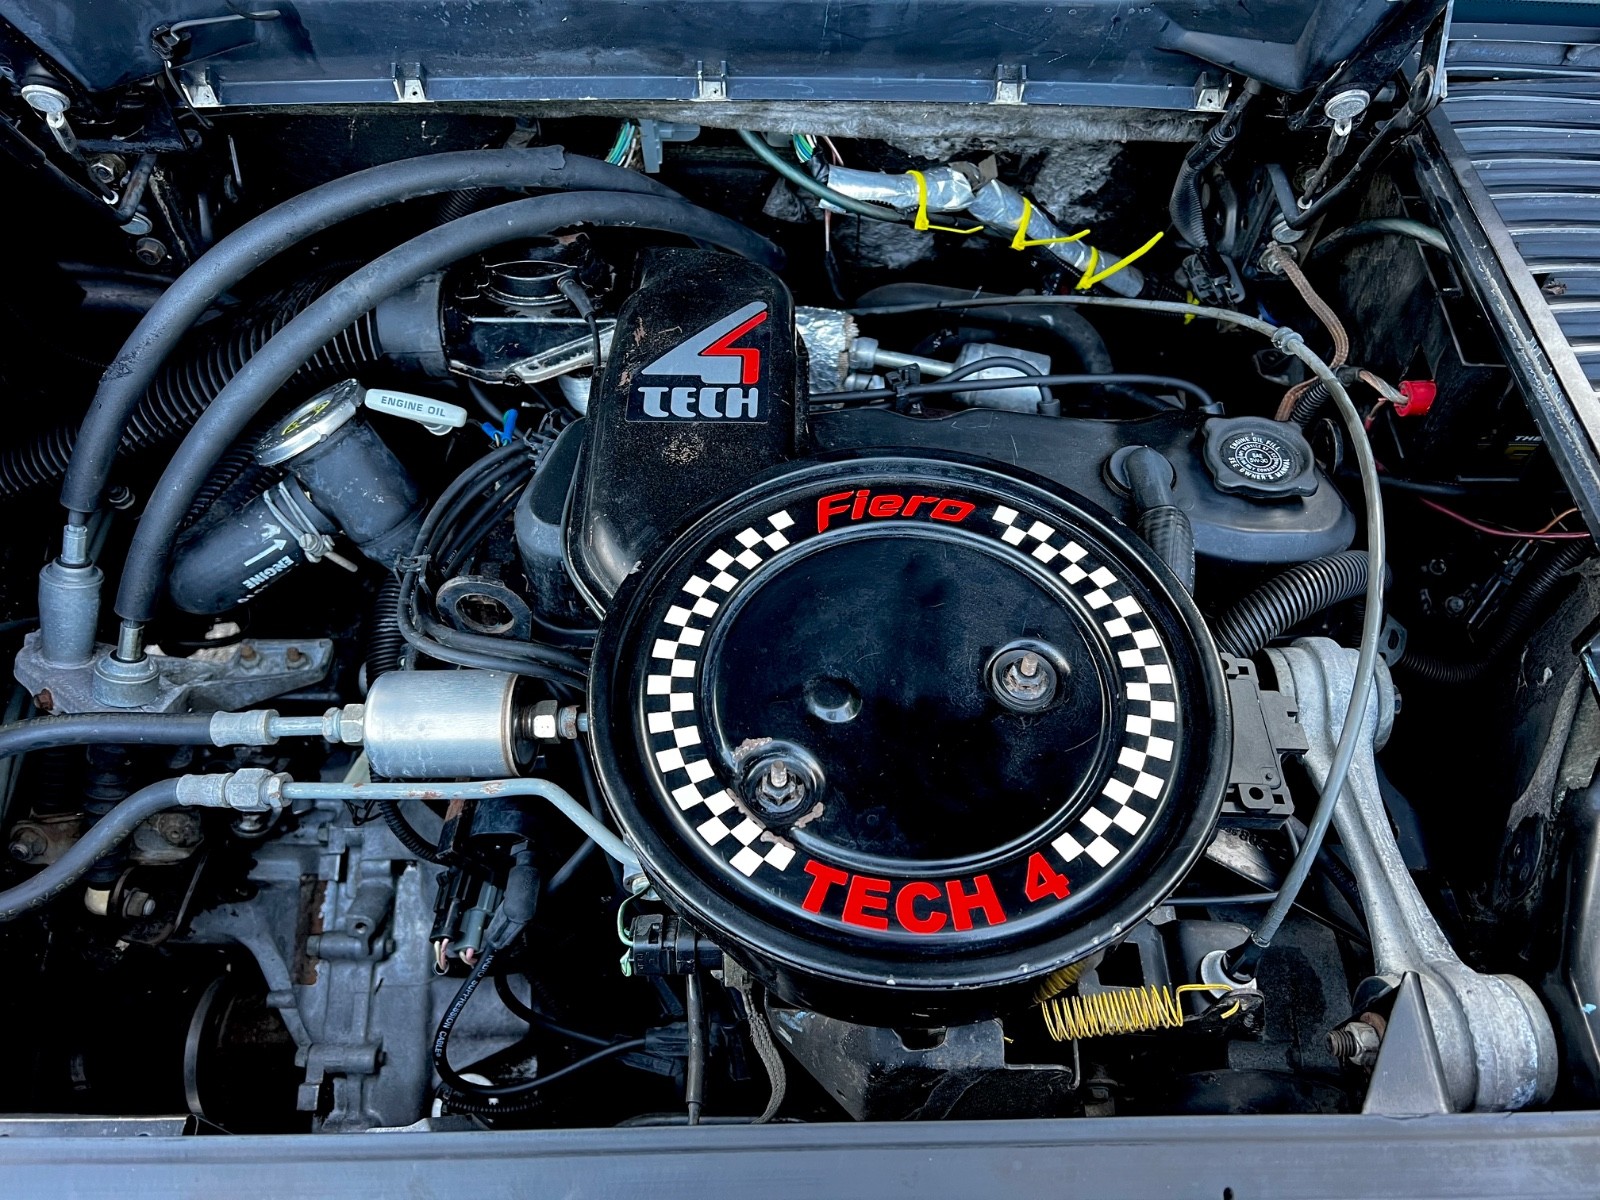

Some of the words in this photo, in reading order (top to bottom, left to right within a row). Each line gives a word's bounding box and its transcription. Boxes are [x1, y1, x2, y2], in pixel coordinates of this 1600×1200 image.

[641, 301, 768, 385] 4
[381, 395, 424, 412] ENGINE
[427, 406, 446, 417] OIL
[637, 387, 759, 418] TECH
[1229, 437, 1250, 450] ENGINE
[1266, 440, 1280, 451] FILL
[1228, 457, 1240, 468] SEE
[1239, 467, 1274, 480] OWNER'S
[1274, 458, 1291, 478] MANUAL
[817, 489, 976, 534] Fiero
[242, 555, 294, 589] ENGINE
[801, 859, 1006, 934] TECH
[1024, 851, 1071, 902] 4
